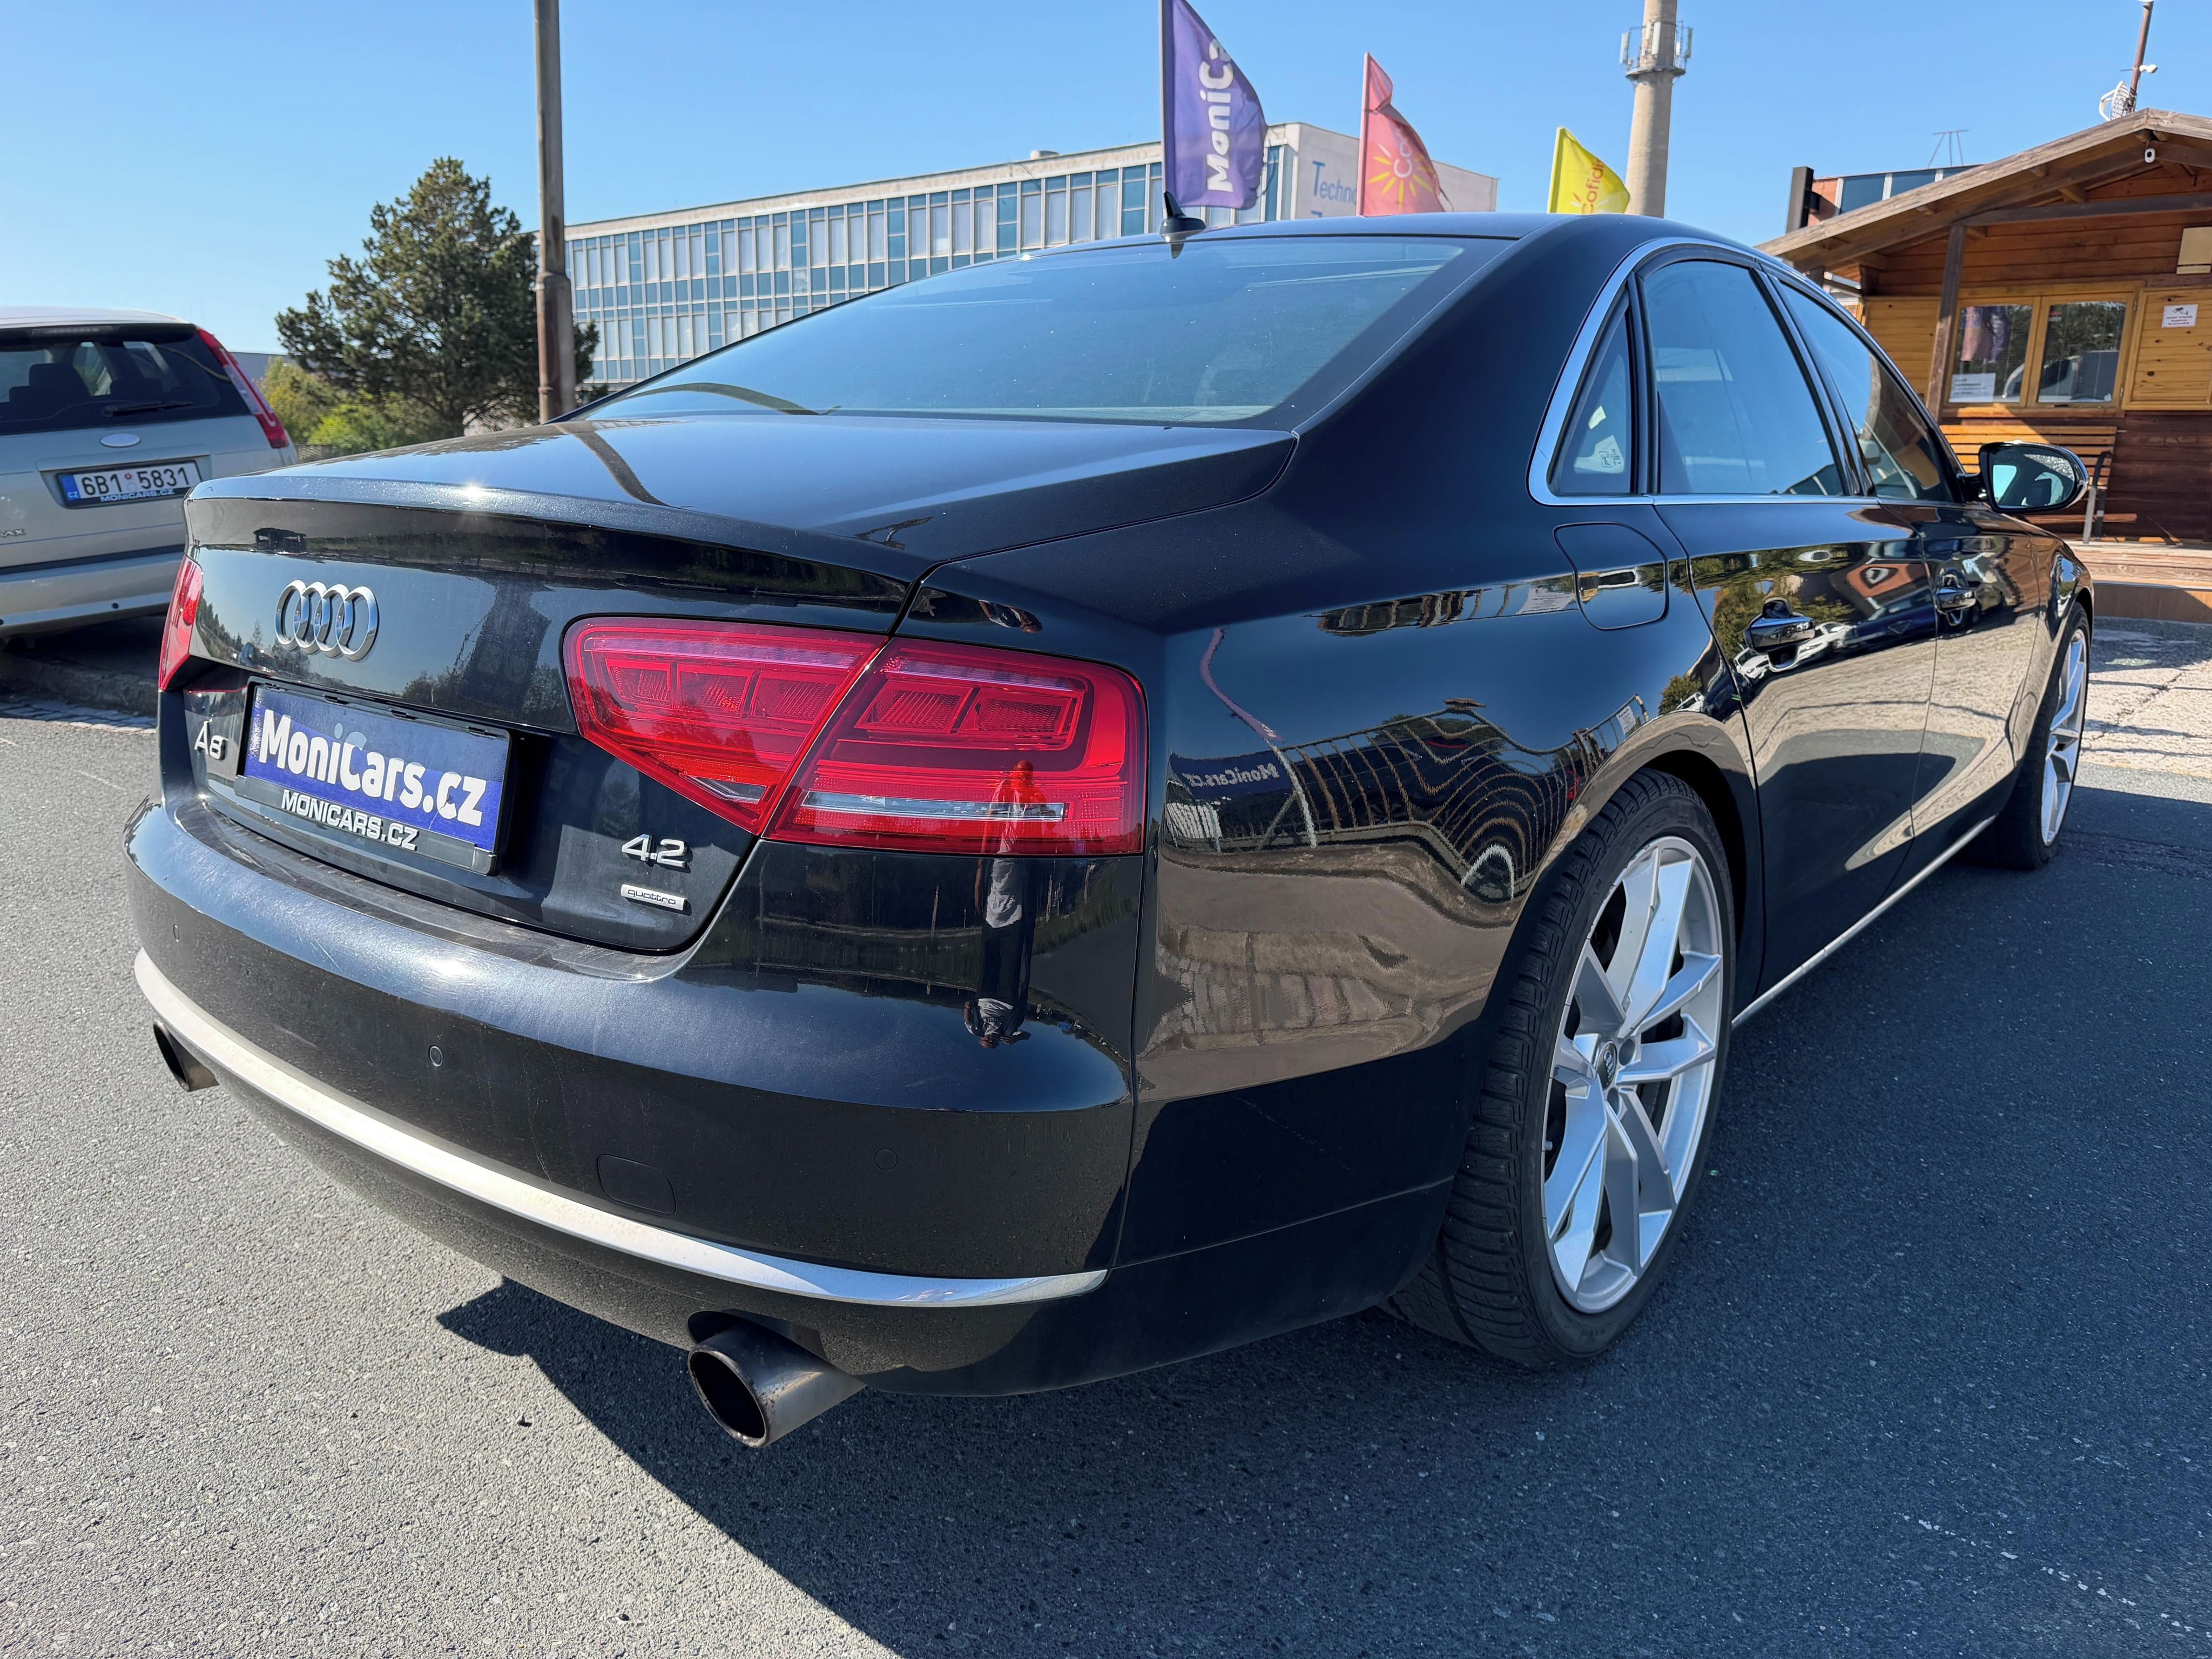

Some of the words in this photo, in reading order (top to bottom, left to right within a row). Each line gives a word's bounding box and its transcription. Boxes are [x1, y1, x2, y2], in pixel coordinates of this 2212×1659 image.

[82, 473, 122, 496] 6B1
[137, 467, 189, 489] 5831
[100, 488, 175, 502] MONICARS.CZ
[194, 720, 226, 759] A8
[259, 709, 487, 826] MoniCars.cz
[281, 789, 420, 851] MONICARS.CZ
[622, 834, 687, 868] 4.2
[628, 889, 676, 905] quattro
